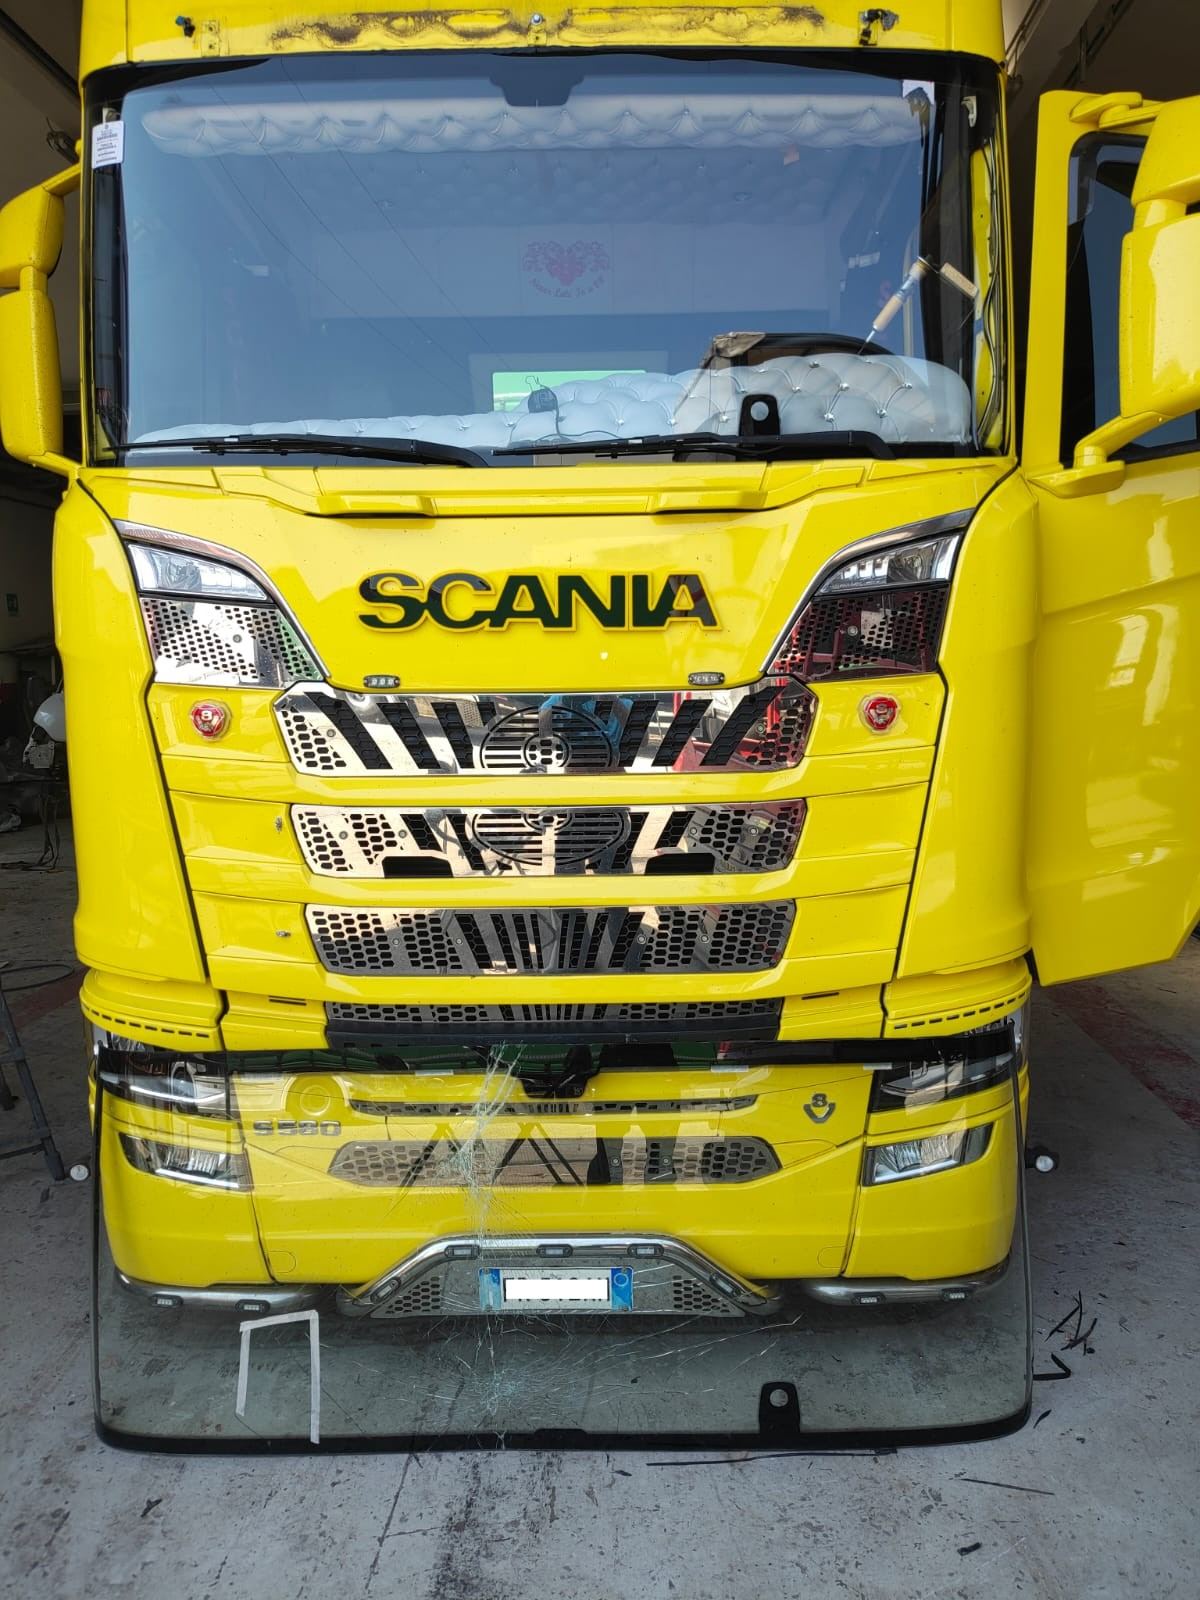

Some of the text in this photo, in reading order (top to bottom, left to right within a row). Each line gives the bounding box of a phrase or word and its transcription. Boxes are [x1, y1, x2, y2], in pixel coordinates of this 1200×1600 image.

[357, 569, 722, 633] SCANIA
[201, 710, 213, 721] 8
[253, 1120, 341, 1136] S 580
